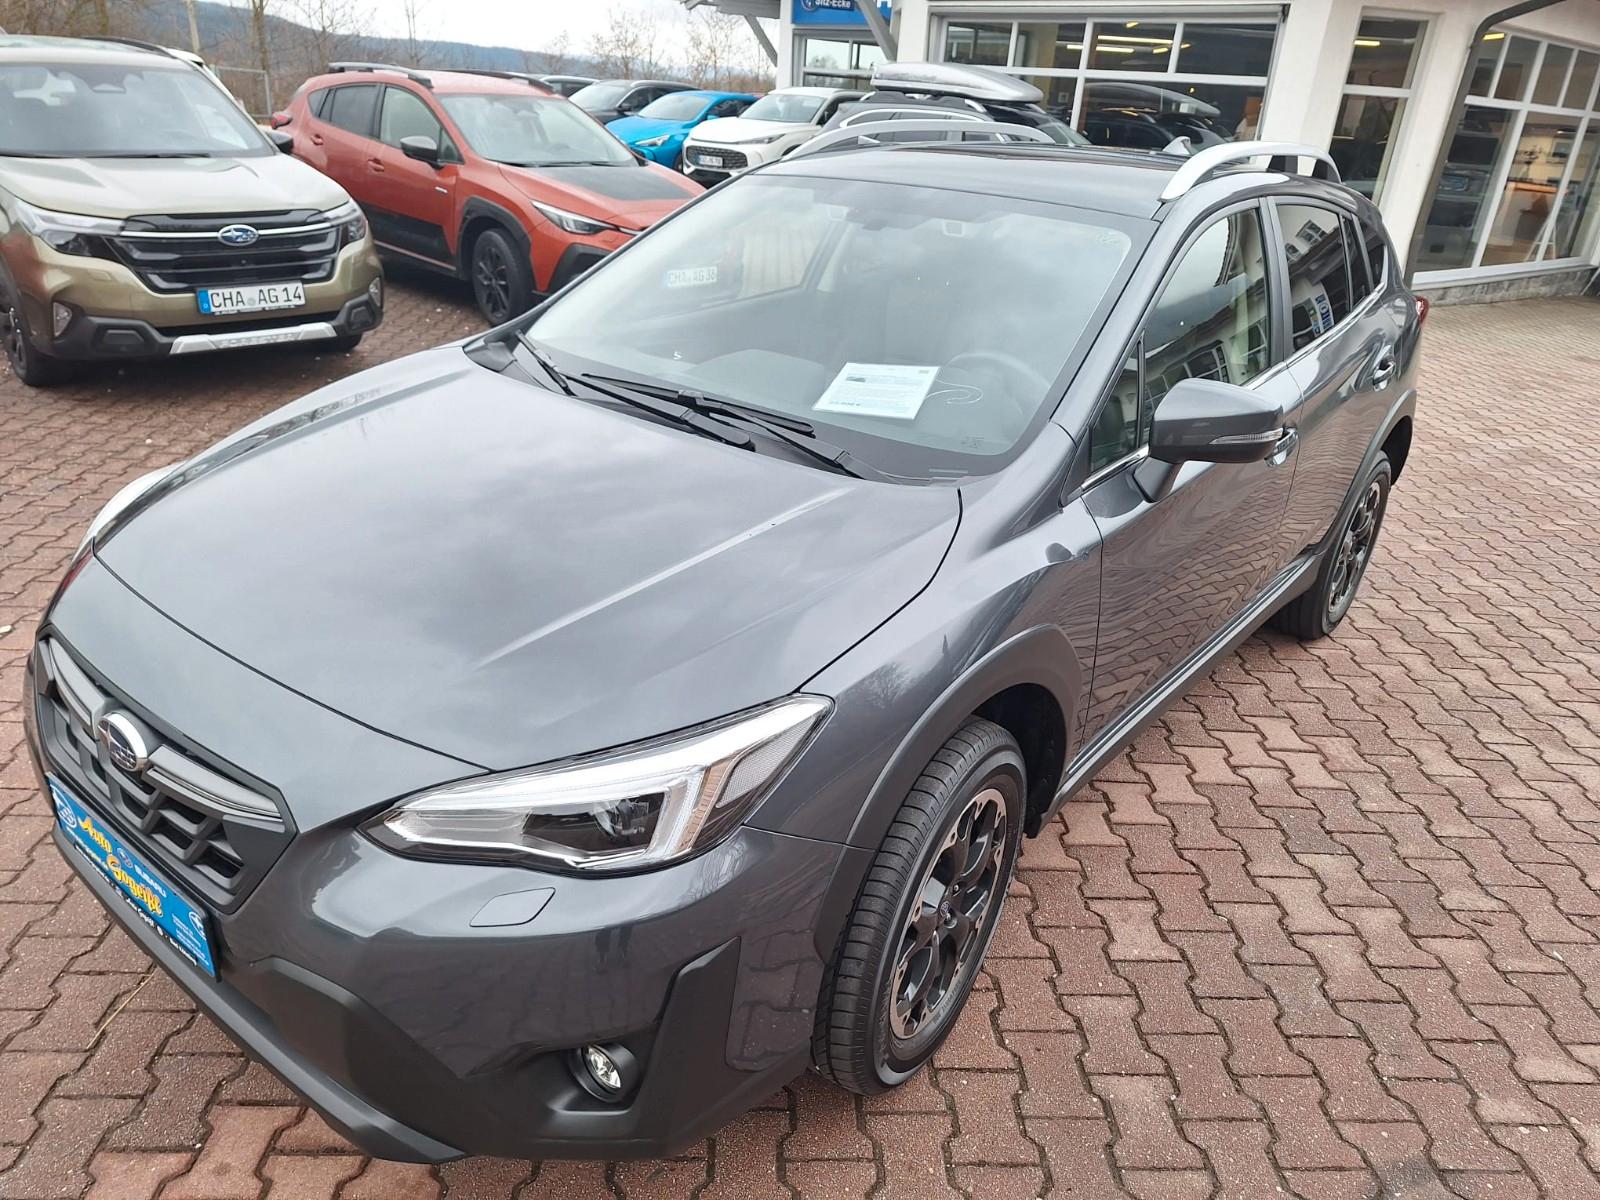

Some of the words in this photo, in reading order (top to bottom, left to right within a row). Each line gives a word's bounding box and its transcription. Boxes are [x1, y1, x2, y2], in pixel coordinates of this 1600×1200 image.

[210, 290, 246, 309] CHA
[258, 288, 279, 305] AG
[282, 286, 302, 303] 14
[134, 864, 167, 898] SUBARU
